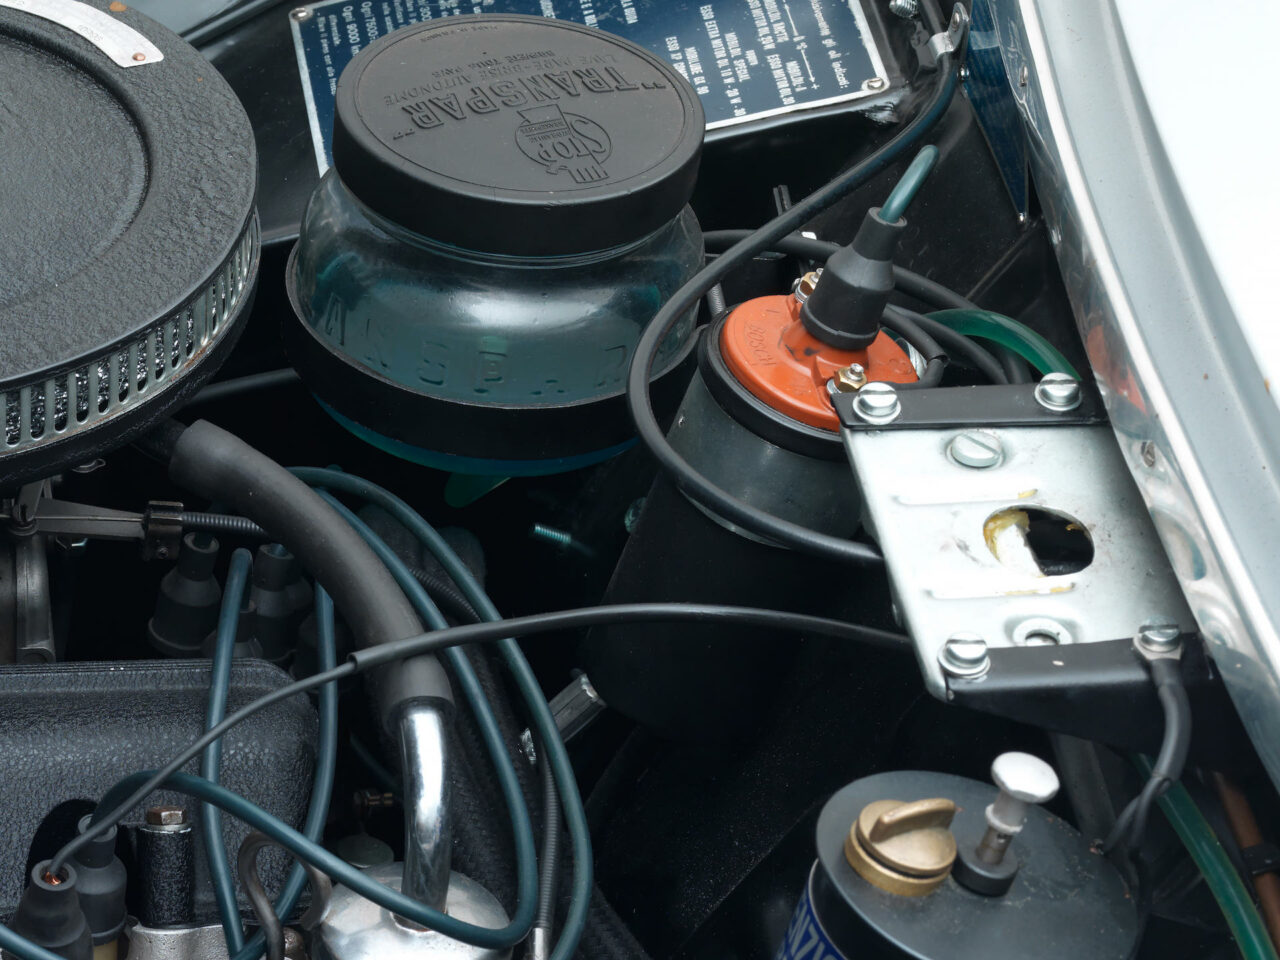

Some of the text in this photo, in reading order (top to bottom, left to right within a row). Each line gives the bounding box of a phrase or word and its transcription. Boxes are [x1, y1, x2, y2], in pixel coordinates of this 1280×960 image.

[342, 6, 355, 22] Ogni
[699, 4, 715, 20] ESSO
[346, 24, 360, 43] 9000
[705, 20, 720, 39] EXTRA
[665, 36, 679, 51] ESSO
[711, 38, 727, 59] MOTOR
[733, 59, 750, 82] SPECIAL
